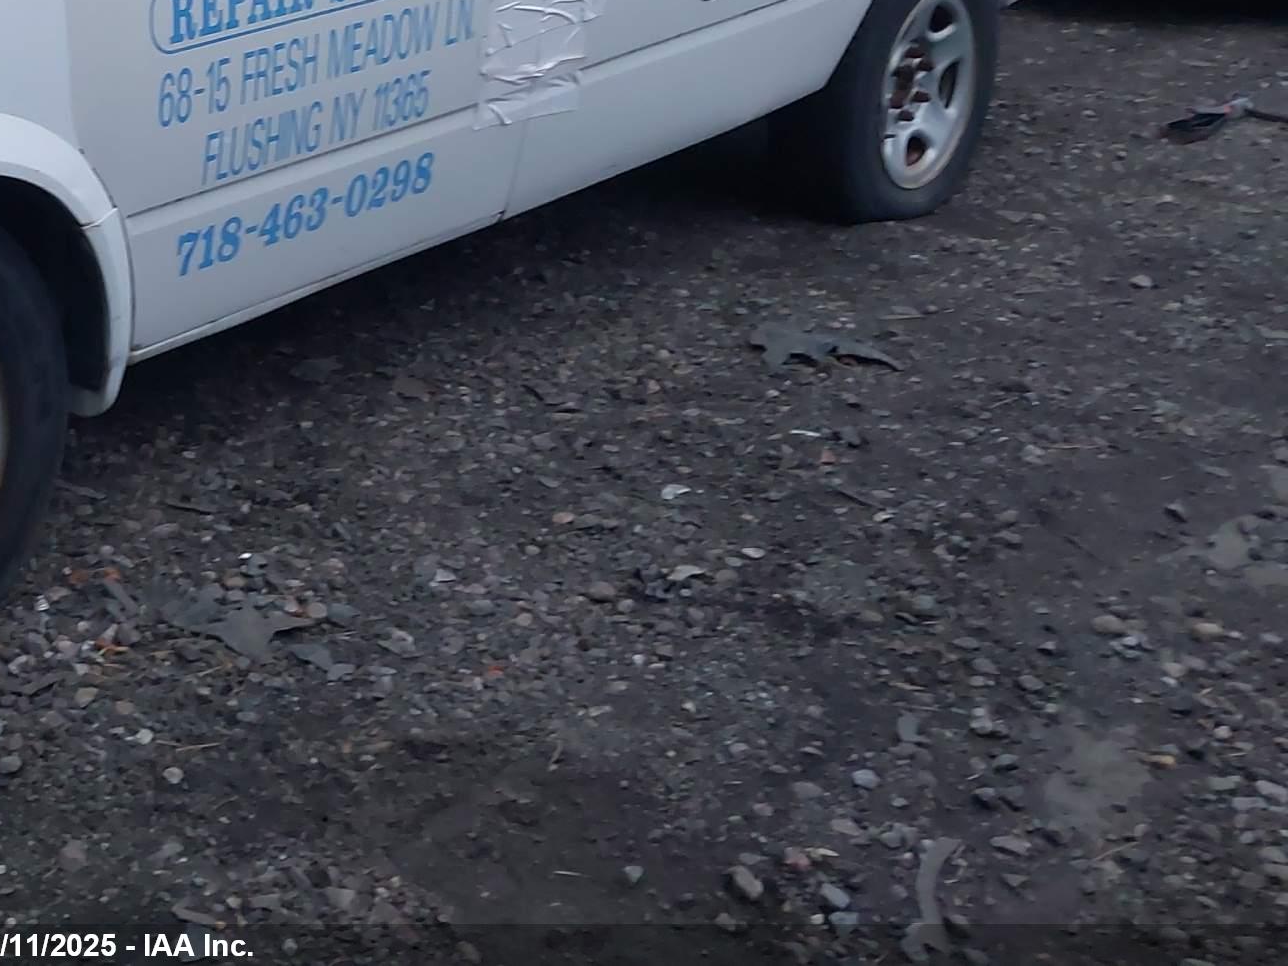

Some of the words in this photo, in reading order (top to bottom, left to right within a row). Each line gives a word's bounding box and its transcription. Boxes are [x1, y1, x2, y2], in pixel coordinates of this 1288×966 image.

[158, 58, 230, 127] 68-15
[241, 35, 318, 105] FRESH
[327, 2, 438, 78] MEADOW
[201, 101, 323, 185] FLUSHING
[329, 88, 367, 141] NY
[372, 69, 431, 131] 11365
[177, 152, 435, 276] 718-463-0298
